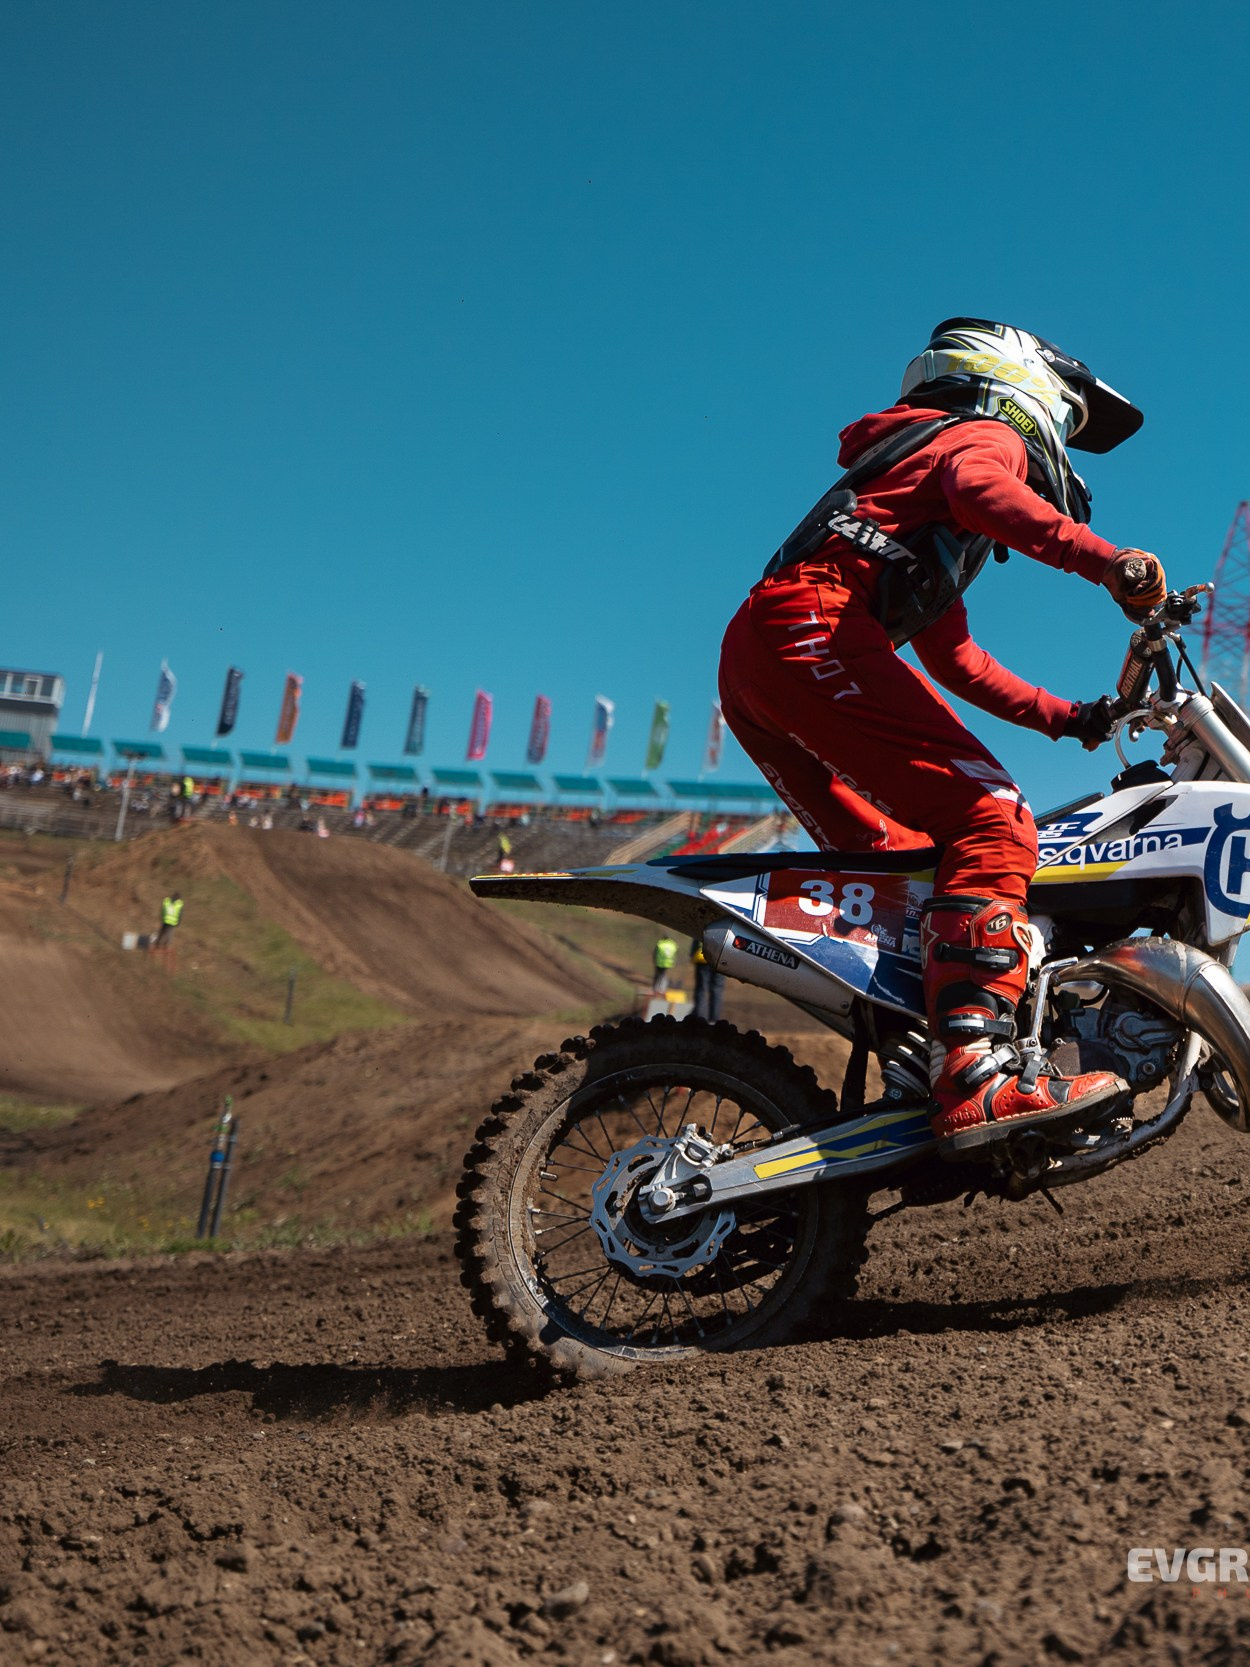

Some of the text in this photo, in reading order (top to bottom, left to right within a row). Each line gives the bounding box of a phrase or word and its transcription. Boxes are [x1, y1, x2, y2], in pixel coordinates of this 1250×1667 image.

[944, 351, 1059, 406] 100%
[1001, 400, 1035, 434] SHOEI
[1120, 660, 1143, 699] RENTHAL
[1045, 821, 1081, 830] TC
[1038, 833, 1184, 871] sqvarna
[798, 879, 875, 926] 38
[988, 915, 1007, 931] T6
[746, 941, 797, 969] ATHENA
